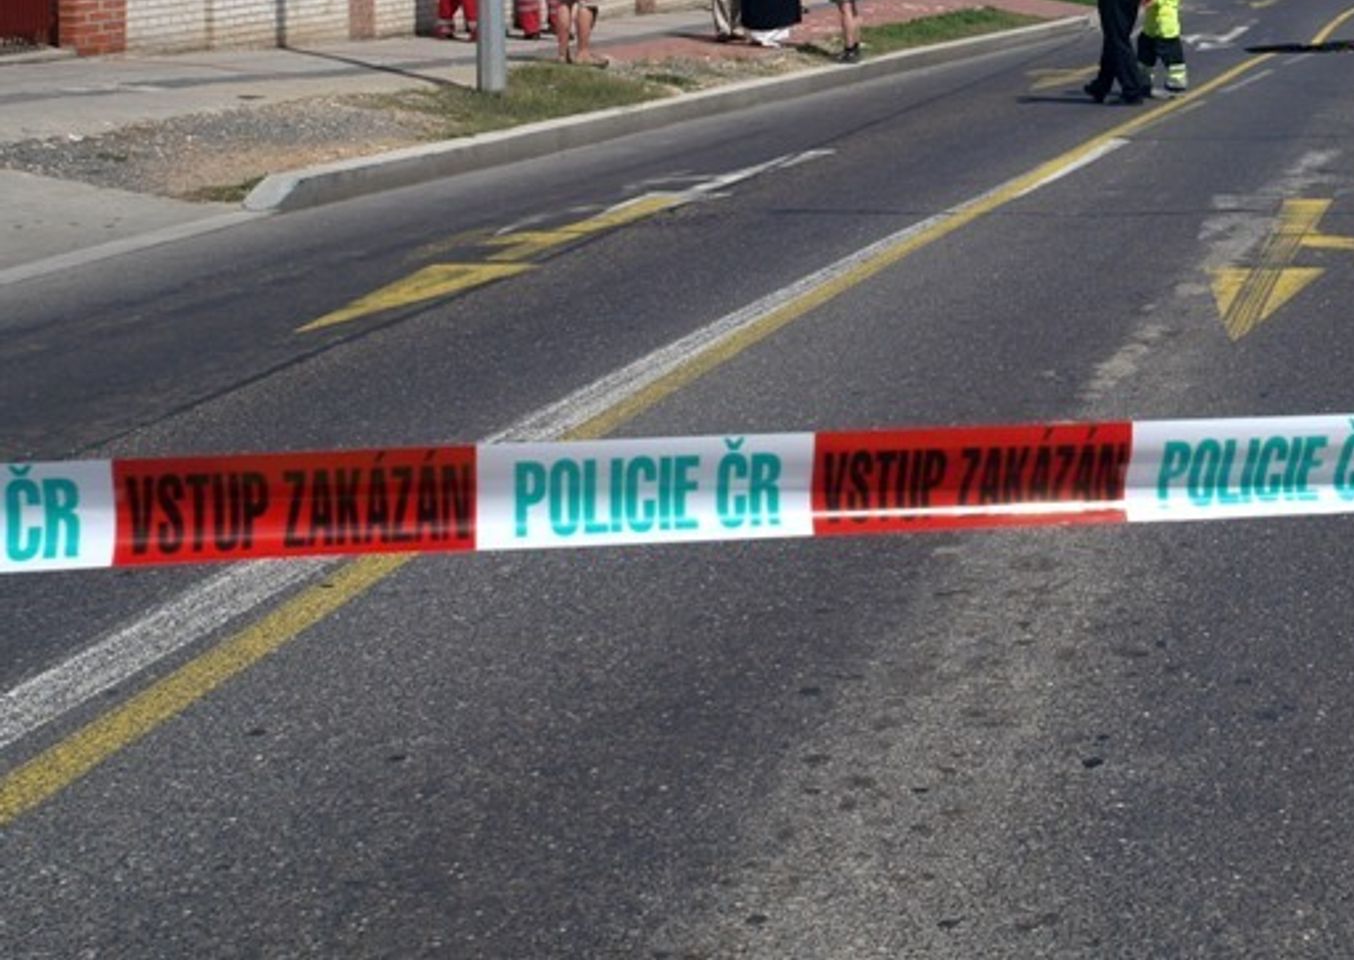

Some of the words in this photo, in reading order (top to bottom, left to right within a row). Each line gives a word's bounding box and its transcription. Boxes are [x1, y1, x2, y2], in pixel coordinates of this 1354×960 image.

[6, 465, 80, 562] ČR
[126, 471, 271, 555] VSTUP
[281, 450, 472, 547] ZAKÁZÁN
[514, 454, 699, 537] POLICIE
[716, 437, 782, 528] ČR
[822, 448, 949, 523] VSTUP
[957, 426, 1131, 513] ZAKÁZÁN
[1157, 435, 1329, 507] POLICIE
